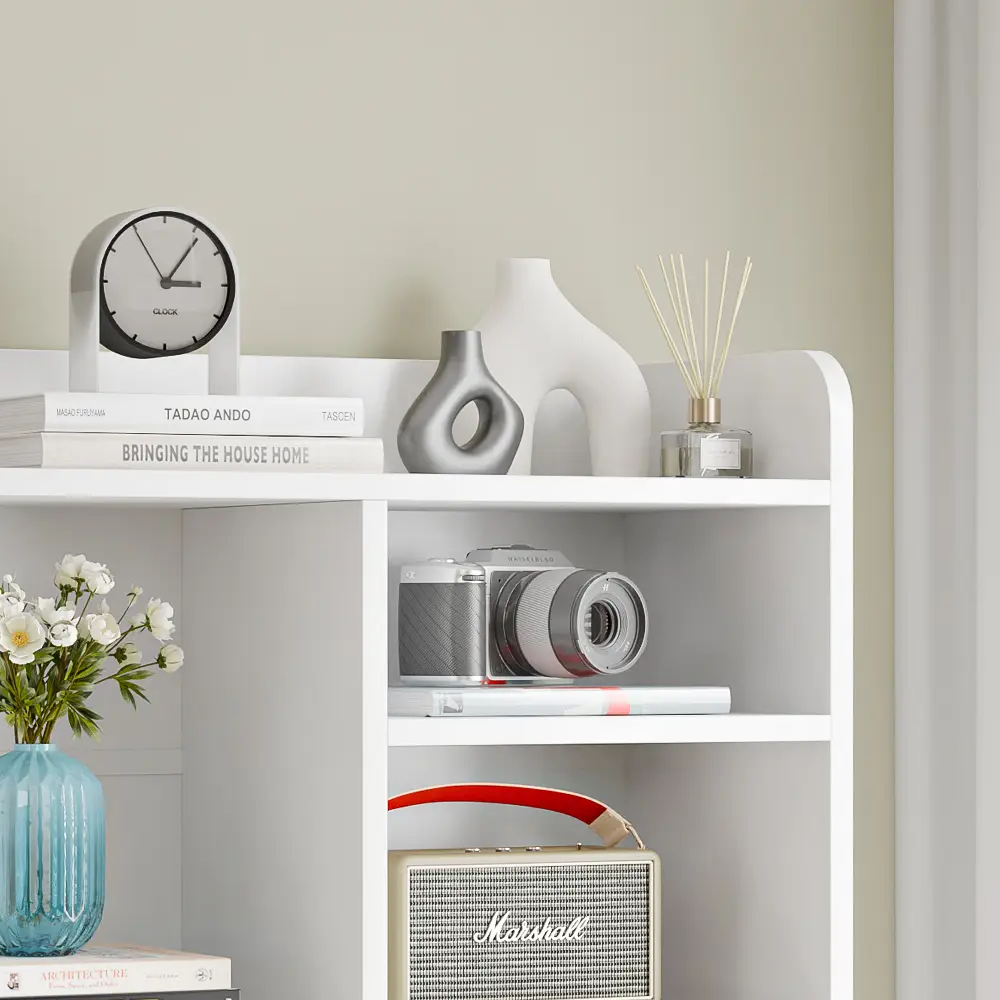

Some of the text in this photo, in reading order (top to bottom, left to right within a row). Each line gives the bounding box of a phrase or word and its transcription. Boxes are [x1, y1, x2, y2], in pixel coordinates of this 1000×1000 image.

[153, 308, 178, 316] CLOCK
[56, 408, 76, 417] MASAO
[164, 407, 251, 422] TADAO ANDO
[122, 443, 310, 464] BRINGING THE HOUSE HOME
[473, 910, 590, 943] Marshall
[41, 968, 129, 982] ARCHITECTURE
